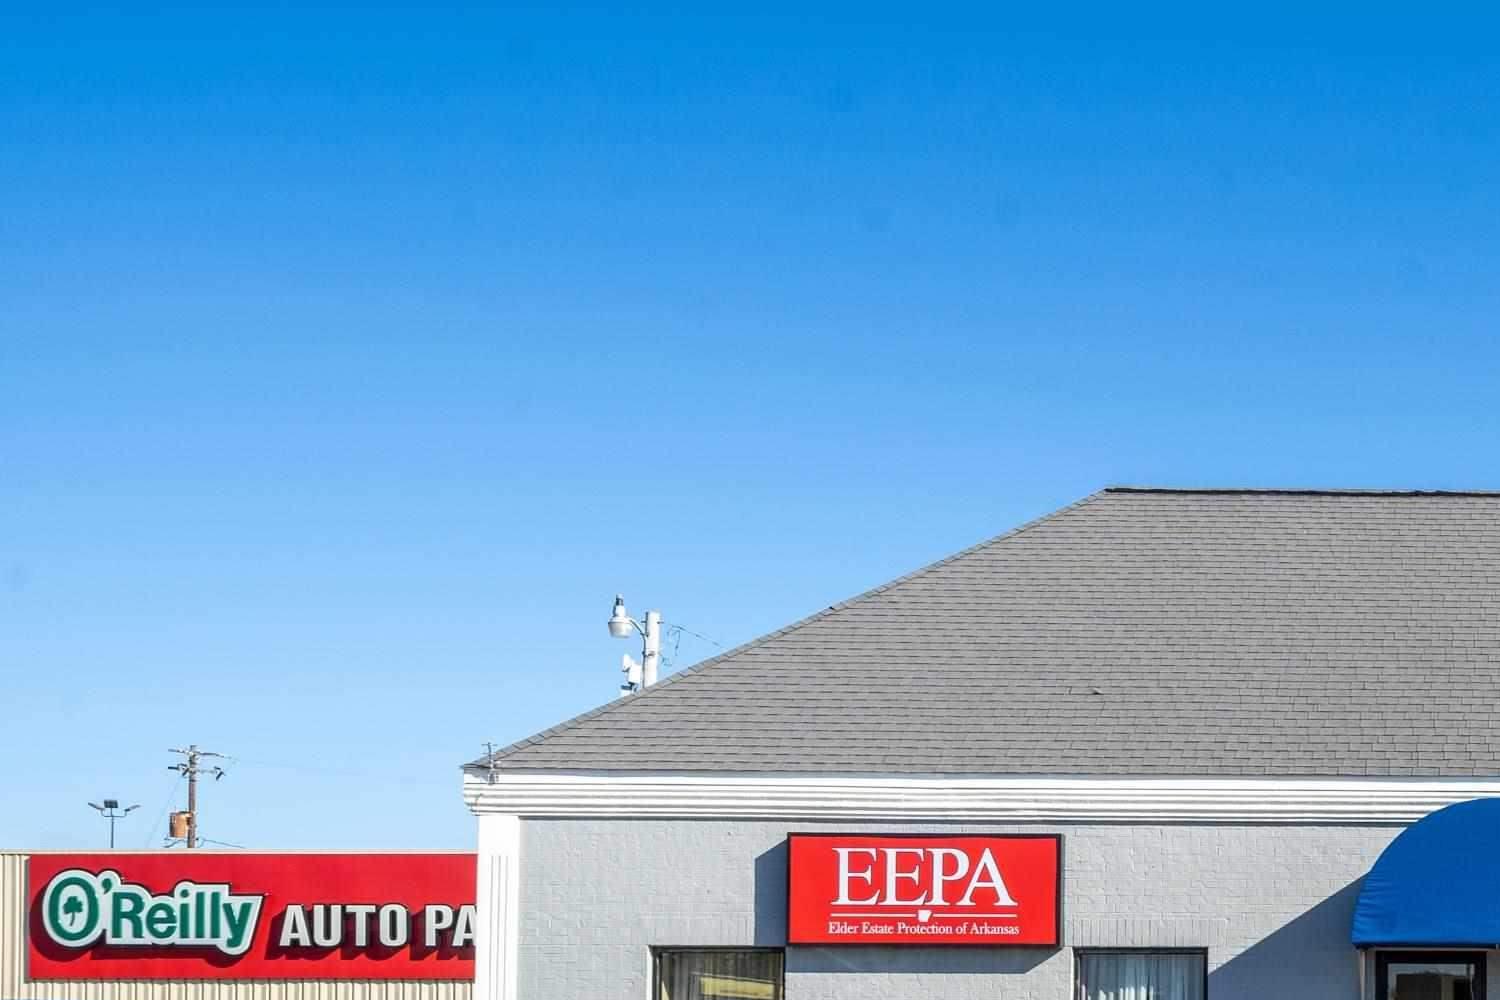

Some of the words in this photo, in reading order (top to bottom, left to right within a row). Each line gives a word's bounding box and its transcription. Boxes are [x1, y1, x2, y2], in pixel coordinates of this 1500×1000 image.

[832, 847, 1018, 906] EEPA
[48, 875, 253, 948] O'Reilly
[280, 905, 408, 947] AUTO
[426, 905, 477, 947] PA
[828, 921, 859, 935] Elder
[862, 921, 894, 935] Estate
[897, 922, 951, 935] Protection
[955, 922, 967, 935] of
[970, 922, 1020, 936] Arkansas
